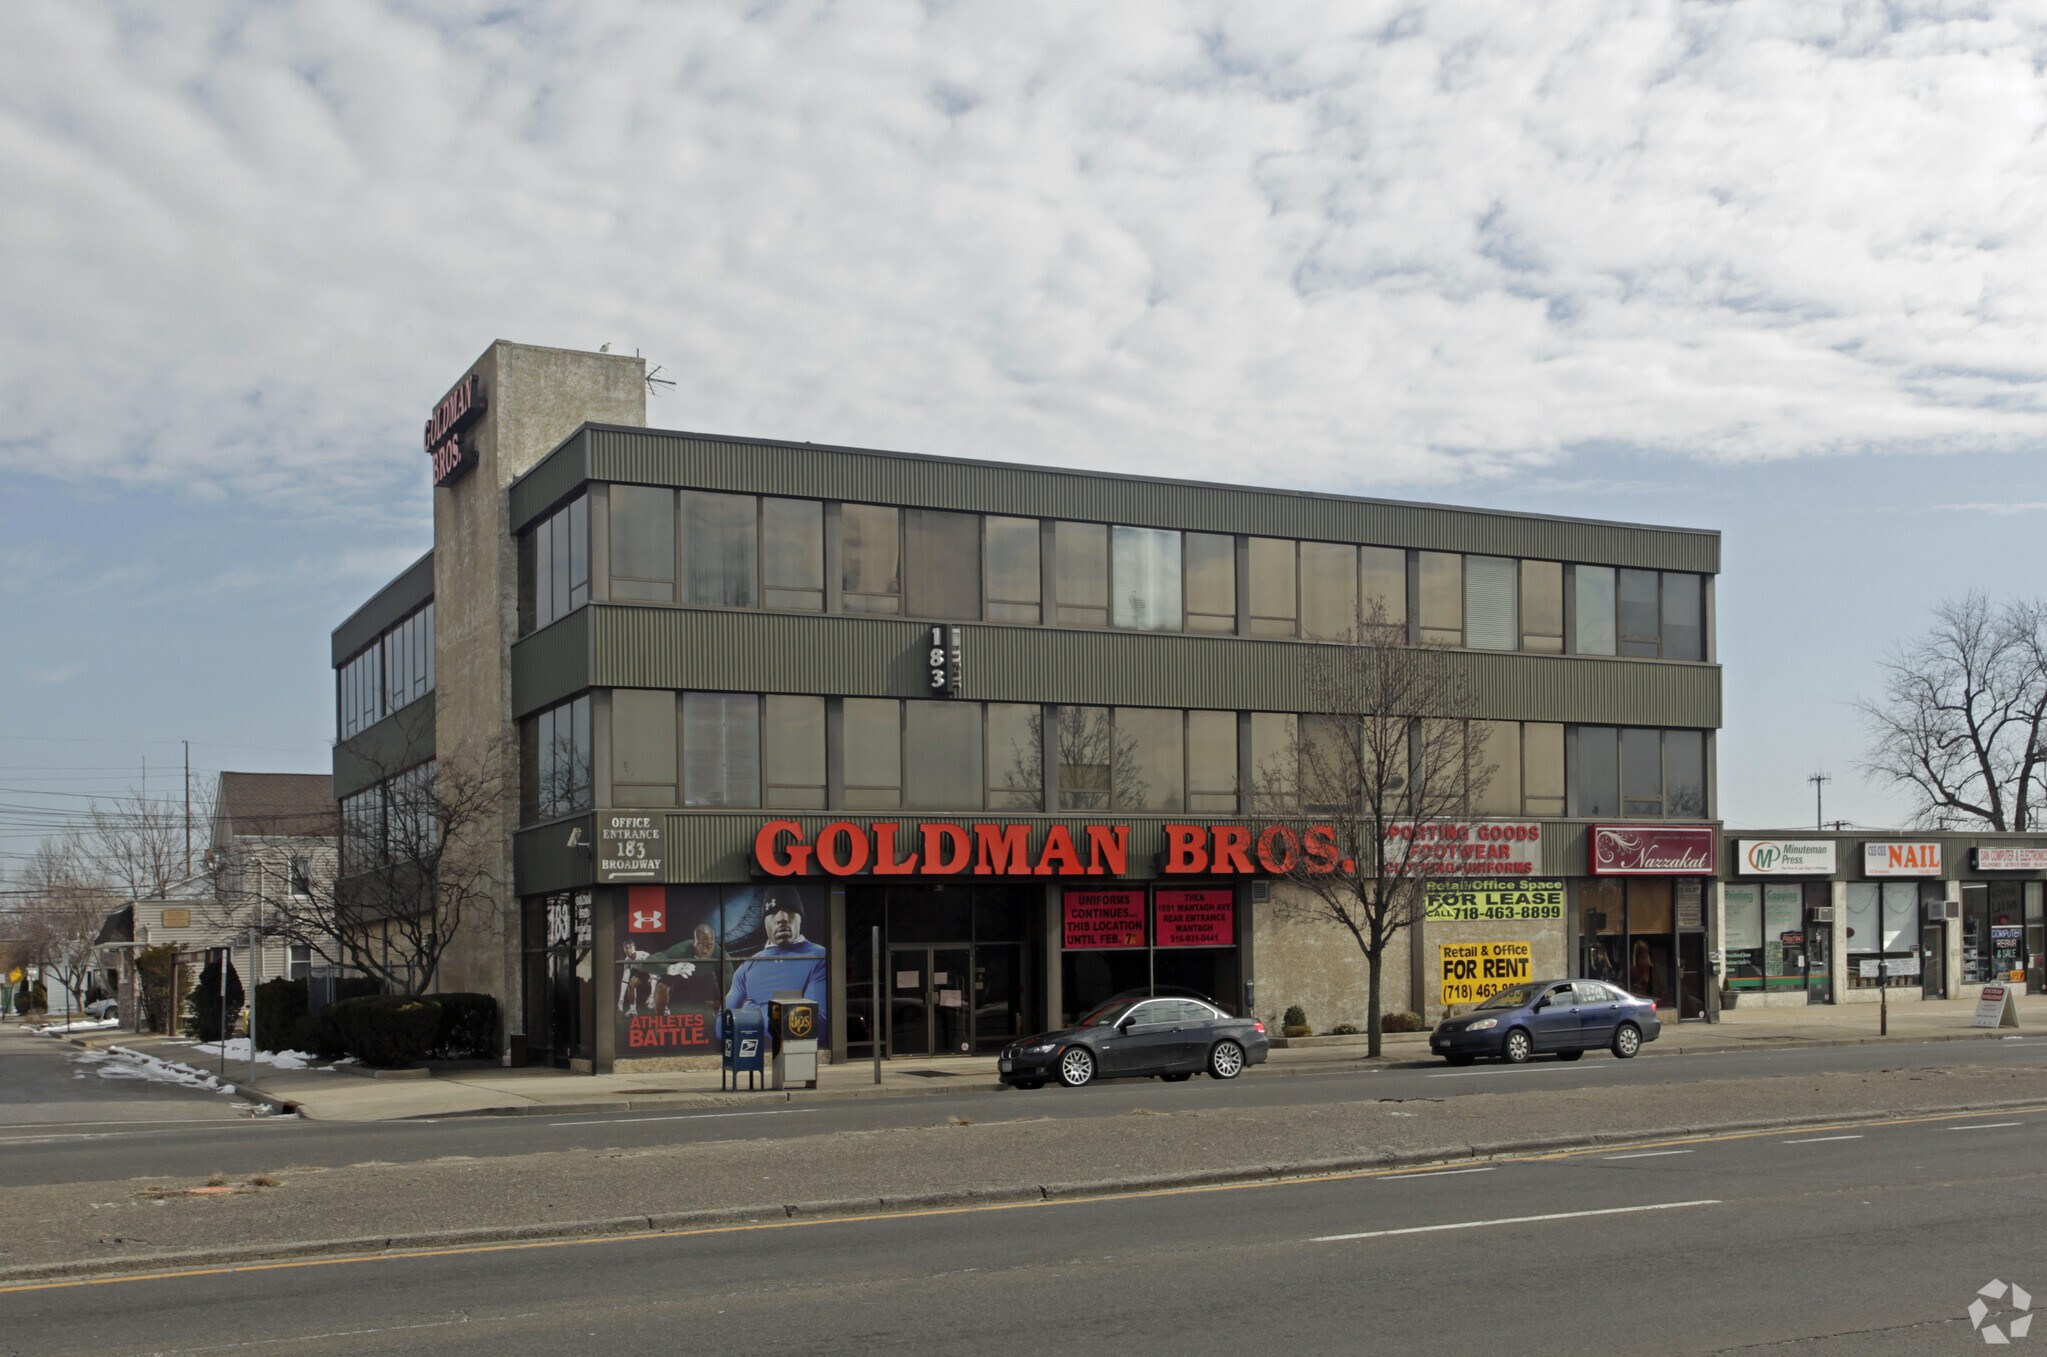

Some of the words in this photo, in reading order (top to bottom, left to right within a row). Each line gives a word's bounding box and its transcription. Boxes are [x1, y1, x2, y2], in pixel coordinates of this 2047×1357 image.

[424, 374, 474, 452] GOLDMAN
[929, 627, 945, 688] 183
[611, 817, 651, 828] OFFICE
[602, 829, 660, 839] ENTRANCE
[1478, 825, 1539, 841] GOODS
[617, 840, 646, 859] 183
[755, 820, 1131, 877] GOLDMAN
[1164, 824, 1356, 874] BROS.
[1409, 843, 1511, 859] FOOTWEAR
[1783, 844, 1828, 854] Minuteman
[1620, 844, 1708, 869] Nazzakat
[1781, 855, 1803, 864] Press
[1888, 844, 1940, 868] NAIL
[601, 859, 661, 870] BROADWAY
[1519, 880, 1562, 891] Space
[1078, 895, 1131, 905] UNIFORMS
[1184, 893, 1205, 902] THEN
[1427, 893, 1477, 907] FOR
[1485, 892, 1561, 905] LEASE
[1725, 890, 1754, 902] Printing
[1766, 890, 1798, 902] Copying
[1071, 908, 1138, 918] CONTINUES...
[1177, 903, 1215, 912] WANTAGH
[1216, 903, 1232, 911] AVE
[1426, 910, 1452, 918] CALL
[1453, 906, 1560, 920] 718-463-8899
[1163, 914, 1183, 922] REAR
[1186, 913, 1226, 922] ENTRANCE
[1067, 921, 1090, 931] THIS
[1093, 920, 1143, 931] LOCATION
[1175, 924, 1213, 932] WANTAGH
[1067, 934, 1097, 944] UNTIL
[1100, 934, 1121, 944] FEB.
[1991, 929, 2022, 938] COMPUTER
[1996, 939, 2017, 948] REPAIR
[1444, 946, 1477, 958] Retail
[1481, 945, 1489, 956] &
[1493, 945, 1528, 955] Office
[2002, 949, 2016, 958] SALE
[1443, 959, 1477, 980] FOR
[1483, 957, 1529, 978] RENT
[1443, 984, 1472, 1003] (718)
[629, 1013, 705, 1029] ATHLETES
[791, 1015, 810, 1032] ups
[629, 1026, 710, 1048] BATTLE.
